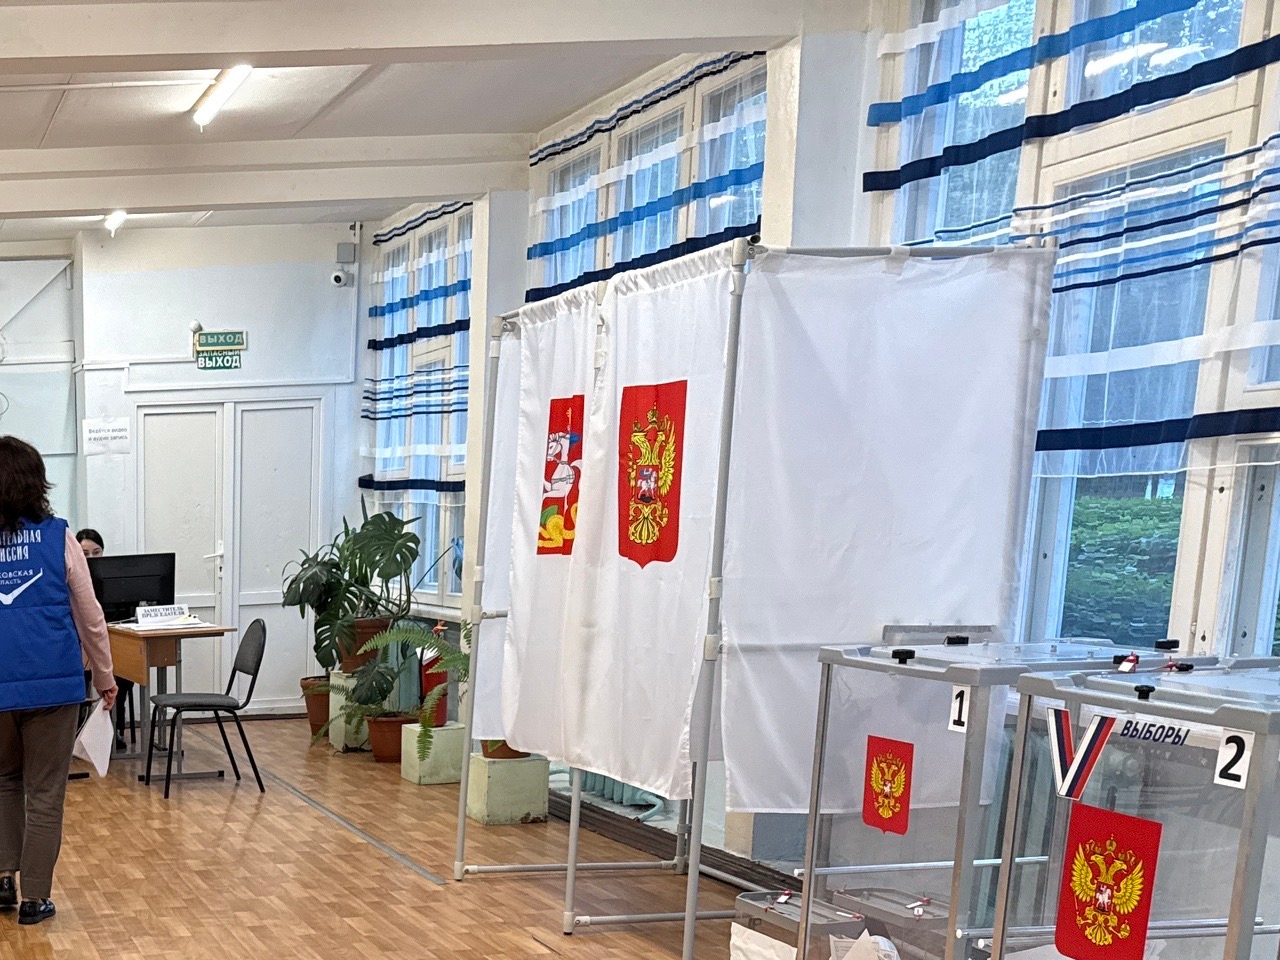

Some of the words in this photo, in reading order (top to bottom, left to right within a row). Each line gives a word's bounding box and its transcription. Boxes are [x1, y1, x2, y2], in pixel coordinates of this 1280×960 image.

[200, 334, 243, 344] ВЫХОД
[198, 356, 240, 368] ВЫХОД
[954, 689, 966, 727] 1
[1120, 719, 1191, 746] ВЫБОРЫ
[1218, 735, 1246, 782] 2
